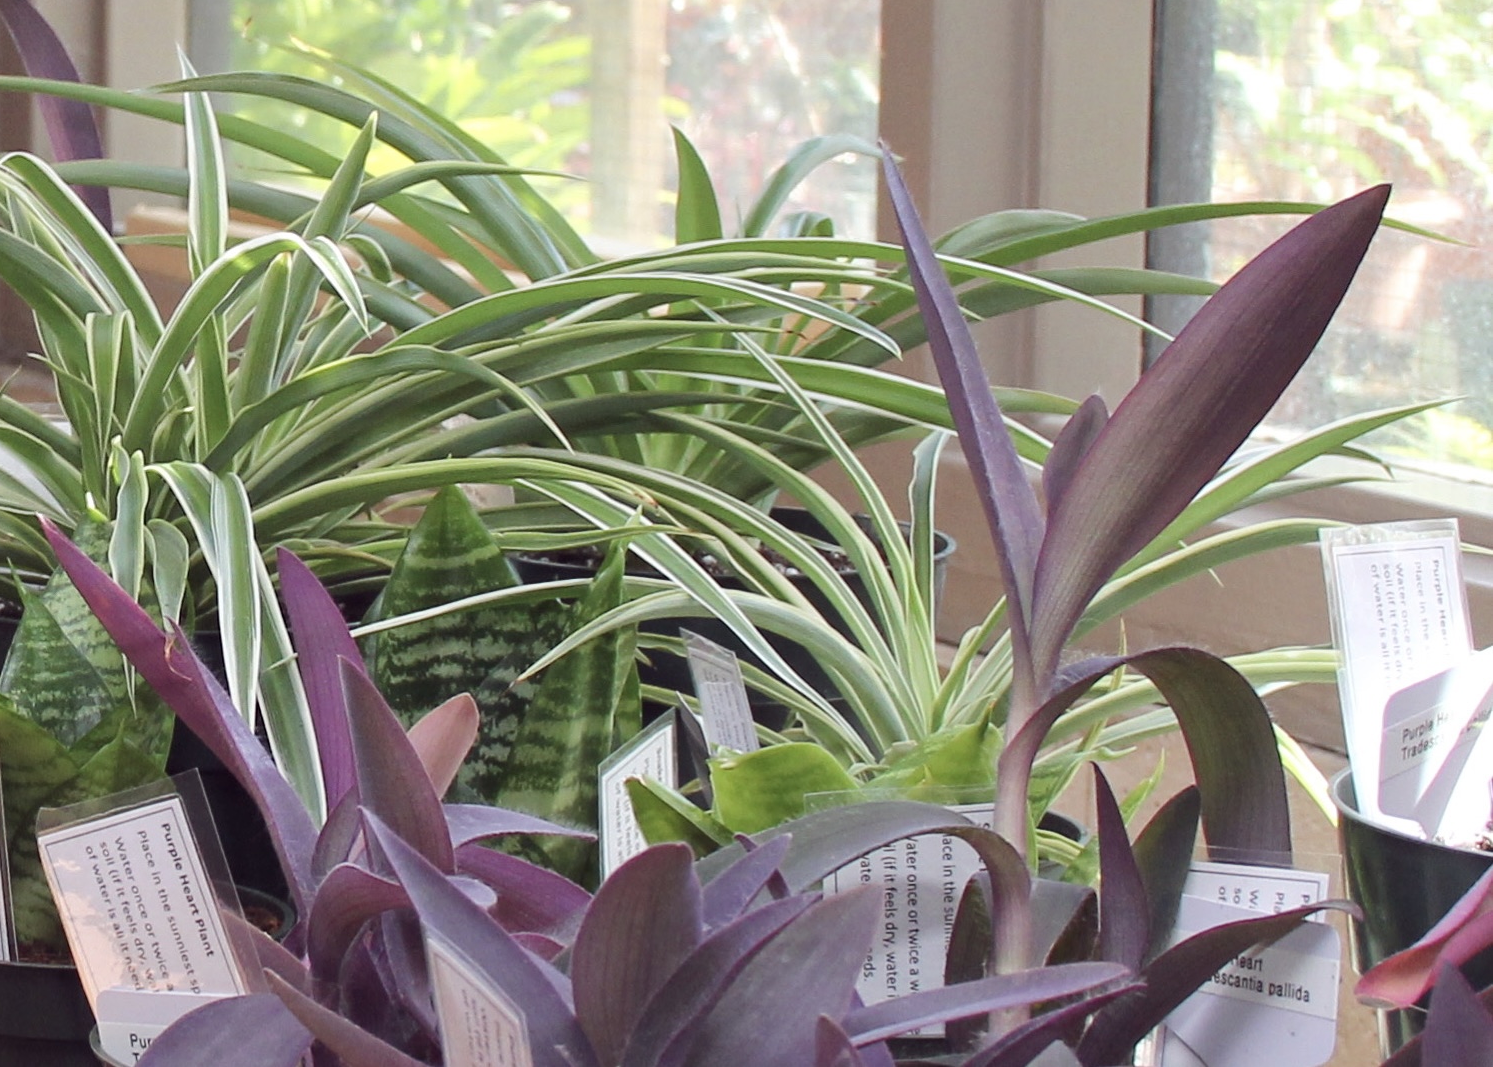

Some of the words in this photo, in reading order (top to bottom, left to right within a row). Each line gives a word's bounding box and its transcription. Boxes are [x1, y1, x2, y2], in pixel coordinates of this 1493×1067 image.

[1371, 564, 1381, 579] of
[1383, 563, 1393, 587] soil
[1415, 562, 1424, 596] Place
[1433, 559, 1444, 605] Purple
[1373, 583, 1384, 623] water
[1395, 563, 1406, 605] Water
[1401, 609, 1411, 643] once
[1419, 601, 1426, 614] in
[881, 856, 897, 870] (if
[884, 874, 895, 882] it
[943, 865, 955, 877] in
[85, 846, 98, 859] of
[92, 864, 111, 904] water
[108, 908, 116, 919] is
[113, 923, 124, 939] all
[120, 943, 129, 952] it
[100, 841, 115, 866] soil
[108, 869, 122, 883] (if
[116, 887, 125, 897] it
[121, 900, 137, 934] feels
[137, 830, 155, 867] Place
[151, 871, 161, 885] in
[158, 889, 171, 912] the
[167, 916, 195, 975] sunniest
[161, 823, 182, 870] Purple
[179, 874, 199, 915] Heart
[195, 918, 214, 957] Plant
[885, 887, 898, 919] feels
[907, 874, 918, 906] once
[943, 882, 956, 903] the
[1218, 886, 1227, 901] of
[115, 836, 135, 881] Water
[131, 885, 148, 918] once
[144, 923, 155, 937] or
[151, 941, 169, 978] twice
[908, 910, 918, 924] or
[882, 922, 898, 948] dry,
[908, 928, 920, 964] twice
[886, 952, 898, 990] water
[1268, 982, 1310, 1003] pallida
